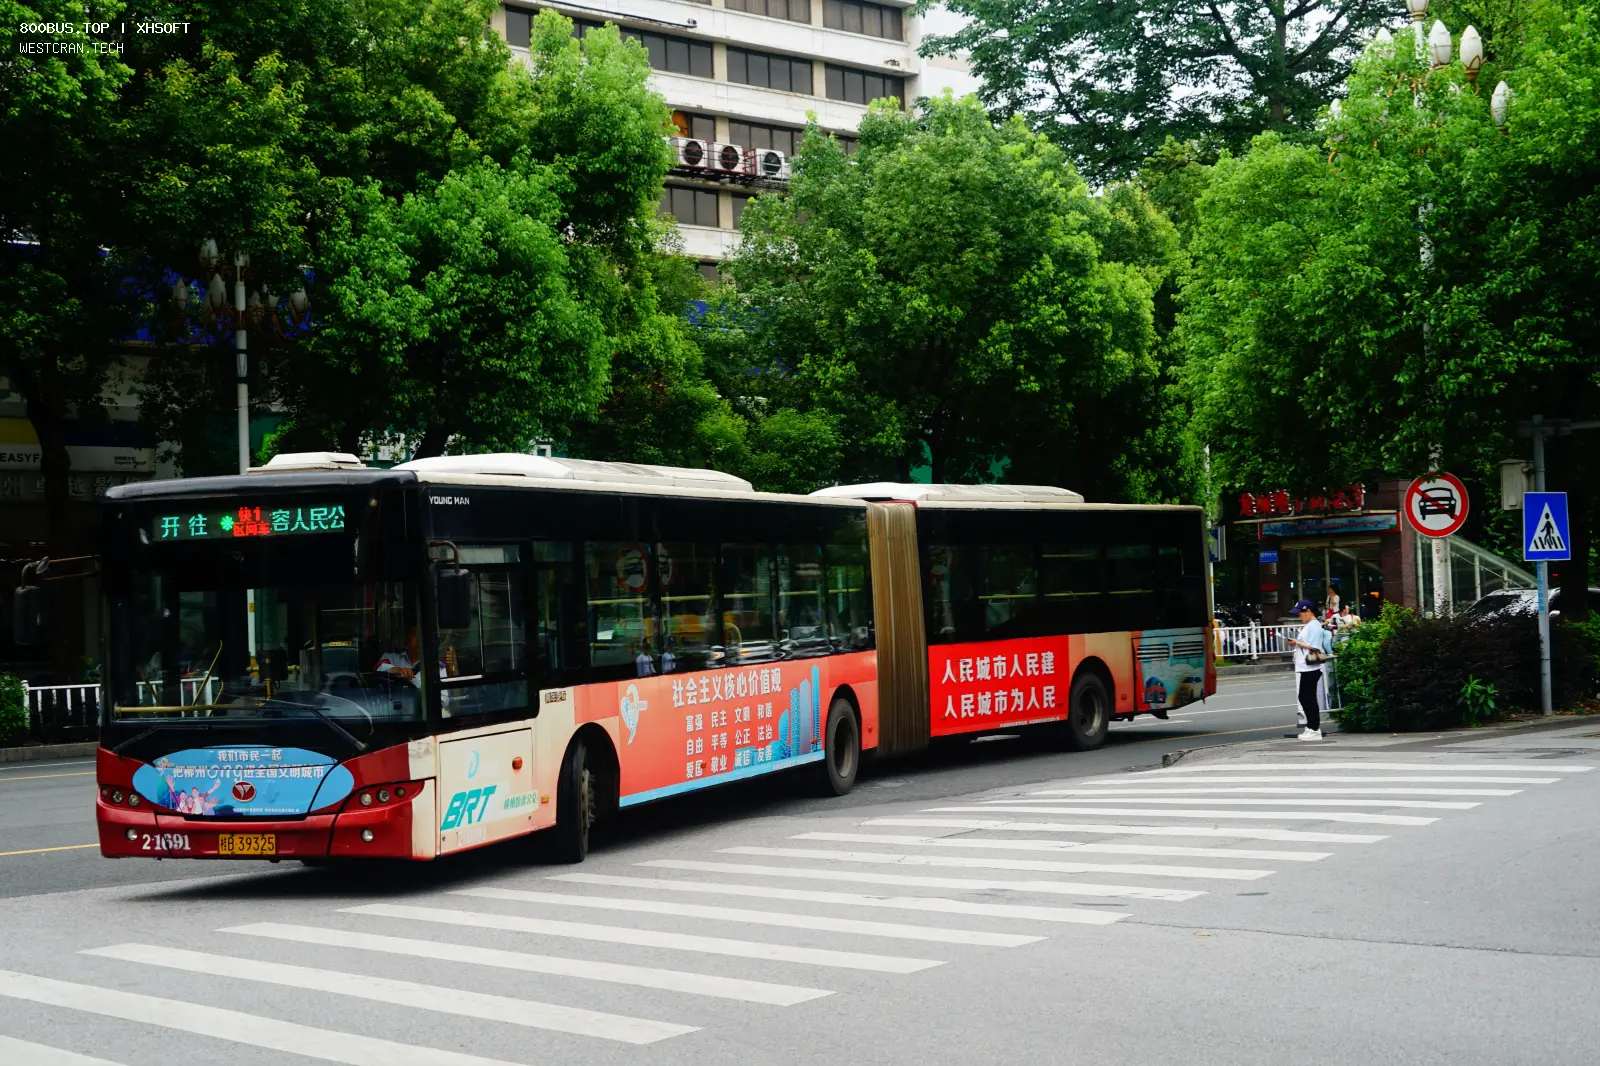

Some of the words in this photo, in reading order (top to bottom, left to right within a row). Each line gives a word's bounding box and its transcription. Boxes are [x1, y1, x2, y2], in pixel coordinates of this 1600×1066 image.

[429, 495, 453, 506] YOUNG
[454, 495, 470, 506] MAN
[160, 513, 208, 538] 开往
[233, 520, 271, 537] 区间车
[942, 651, 1055, 684] 人民城市人民建
[672, 668, 782, 708] 社会主义核心价值观
[944, 685, 1056, 718] 人民城市为人民
[685, 713, 704, 733] 富强
[711, 710, 728, 728] 民主
[734, 706, 751, 724] 文明
[757, 702, 773, 719] 和谐
[217, 749, 282, 762] 我们市民一起
[685, 737, 704, 756] 自由
[711, 733, 728, 751] 平等
[734, 728, 751, 746] 公正
[757, 724, 773, 742] 法治
[685, 760, 704, 779] 爱国
[710, 754, 728, 773] 敬业
[734, 749, 751, 768] 诚信
[757, 745, 773, 763] 友善
[440, 784, 498, 831] BRT
